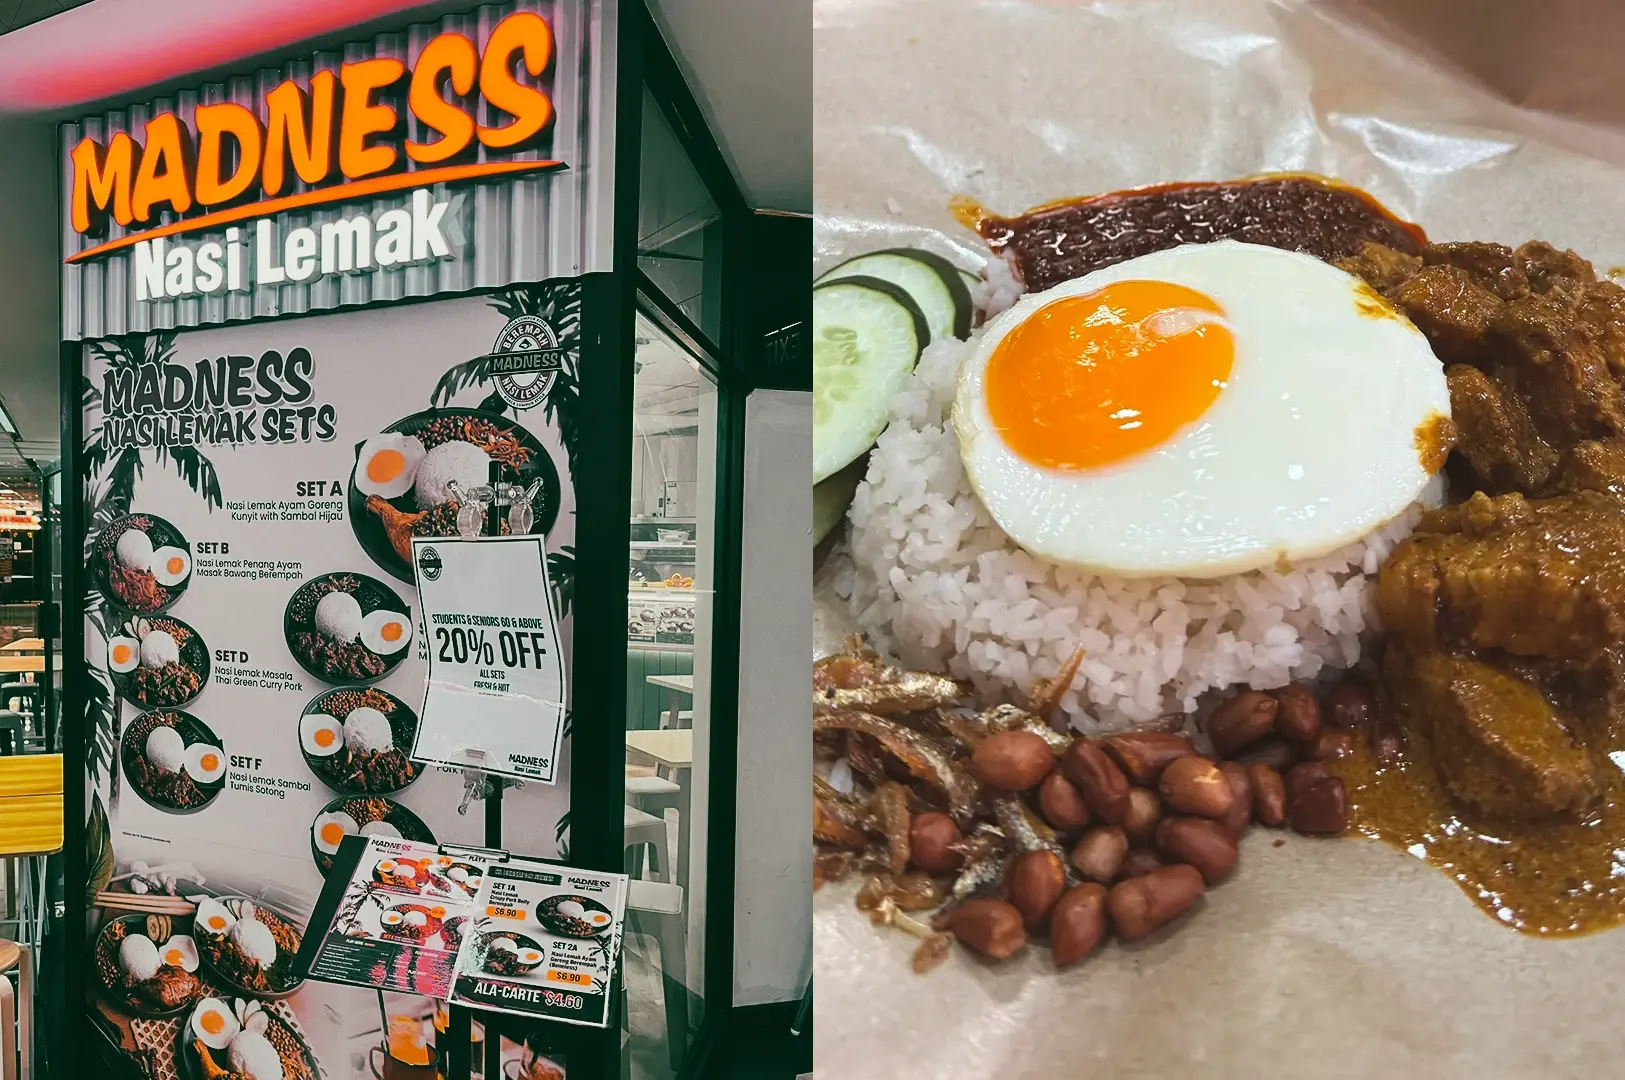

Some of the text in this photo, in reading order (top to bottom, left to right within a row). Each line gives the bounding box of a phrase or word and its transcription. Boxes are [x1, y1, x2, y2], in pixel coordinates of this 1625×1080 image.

[71, 11, 552, 234] MADNESS
[135, 188, 453, 303] Nasi Lemak
[503, 324, 549, 349] BEREMPAH
[493, 352, 558, 371] MADNESS
[102, 347, 313, 416] MADNESS
[502, 375, 548, 399] NASI LEMAK
[102, 404, 336, 449] NASI LEMAK SETS
[296, 480, 343, 497] SET A
[226, 500, 343, 512] Nasi Lemak Ayam Goreng
[231, 511, 343, 523] Kunyit with Sambal Hijau
[197, 542, 229, 554] SET B
[197, 559, 302, 571] Nasi Lemak Penang Ayam
[196, 568, 303, 581] Masak Bawang Berempah
[432, 614, 543, 629] STUDENTS & SENIORS 60 & ABOVE
[435, 627, 547, 669] 20% OFF
[215, 649, 249, 663] SET D
[215, 666, 293, 680] Nasi Lemak Masala
[479, 669, 505, 680] ALL SETS
[215, 676, 303, 691] Thai Green Curry Pork
[230, 755, 262, 770] SET F
[508, 753, 549, 768] MADNESS
[229, 772, 311, 791] Nasi Lemak Sambal
[230, 781, 285, 799] Tumis Sotong
[371, 839, 412, 852] MADNESS
[493, 882, 516, 892] SET 1A
[568, 877, 610, 888] MADNESS
[494, 907, 517, 917] $6.90
[552, 941, 577, 951] SET 2A
[556, 971, 581, 982] $6.90
[474, 982, 541, 1003] ALA-CARTE
[545, 991, 583, 1010] $4.60
